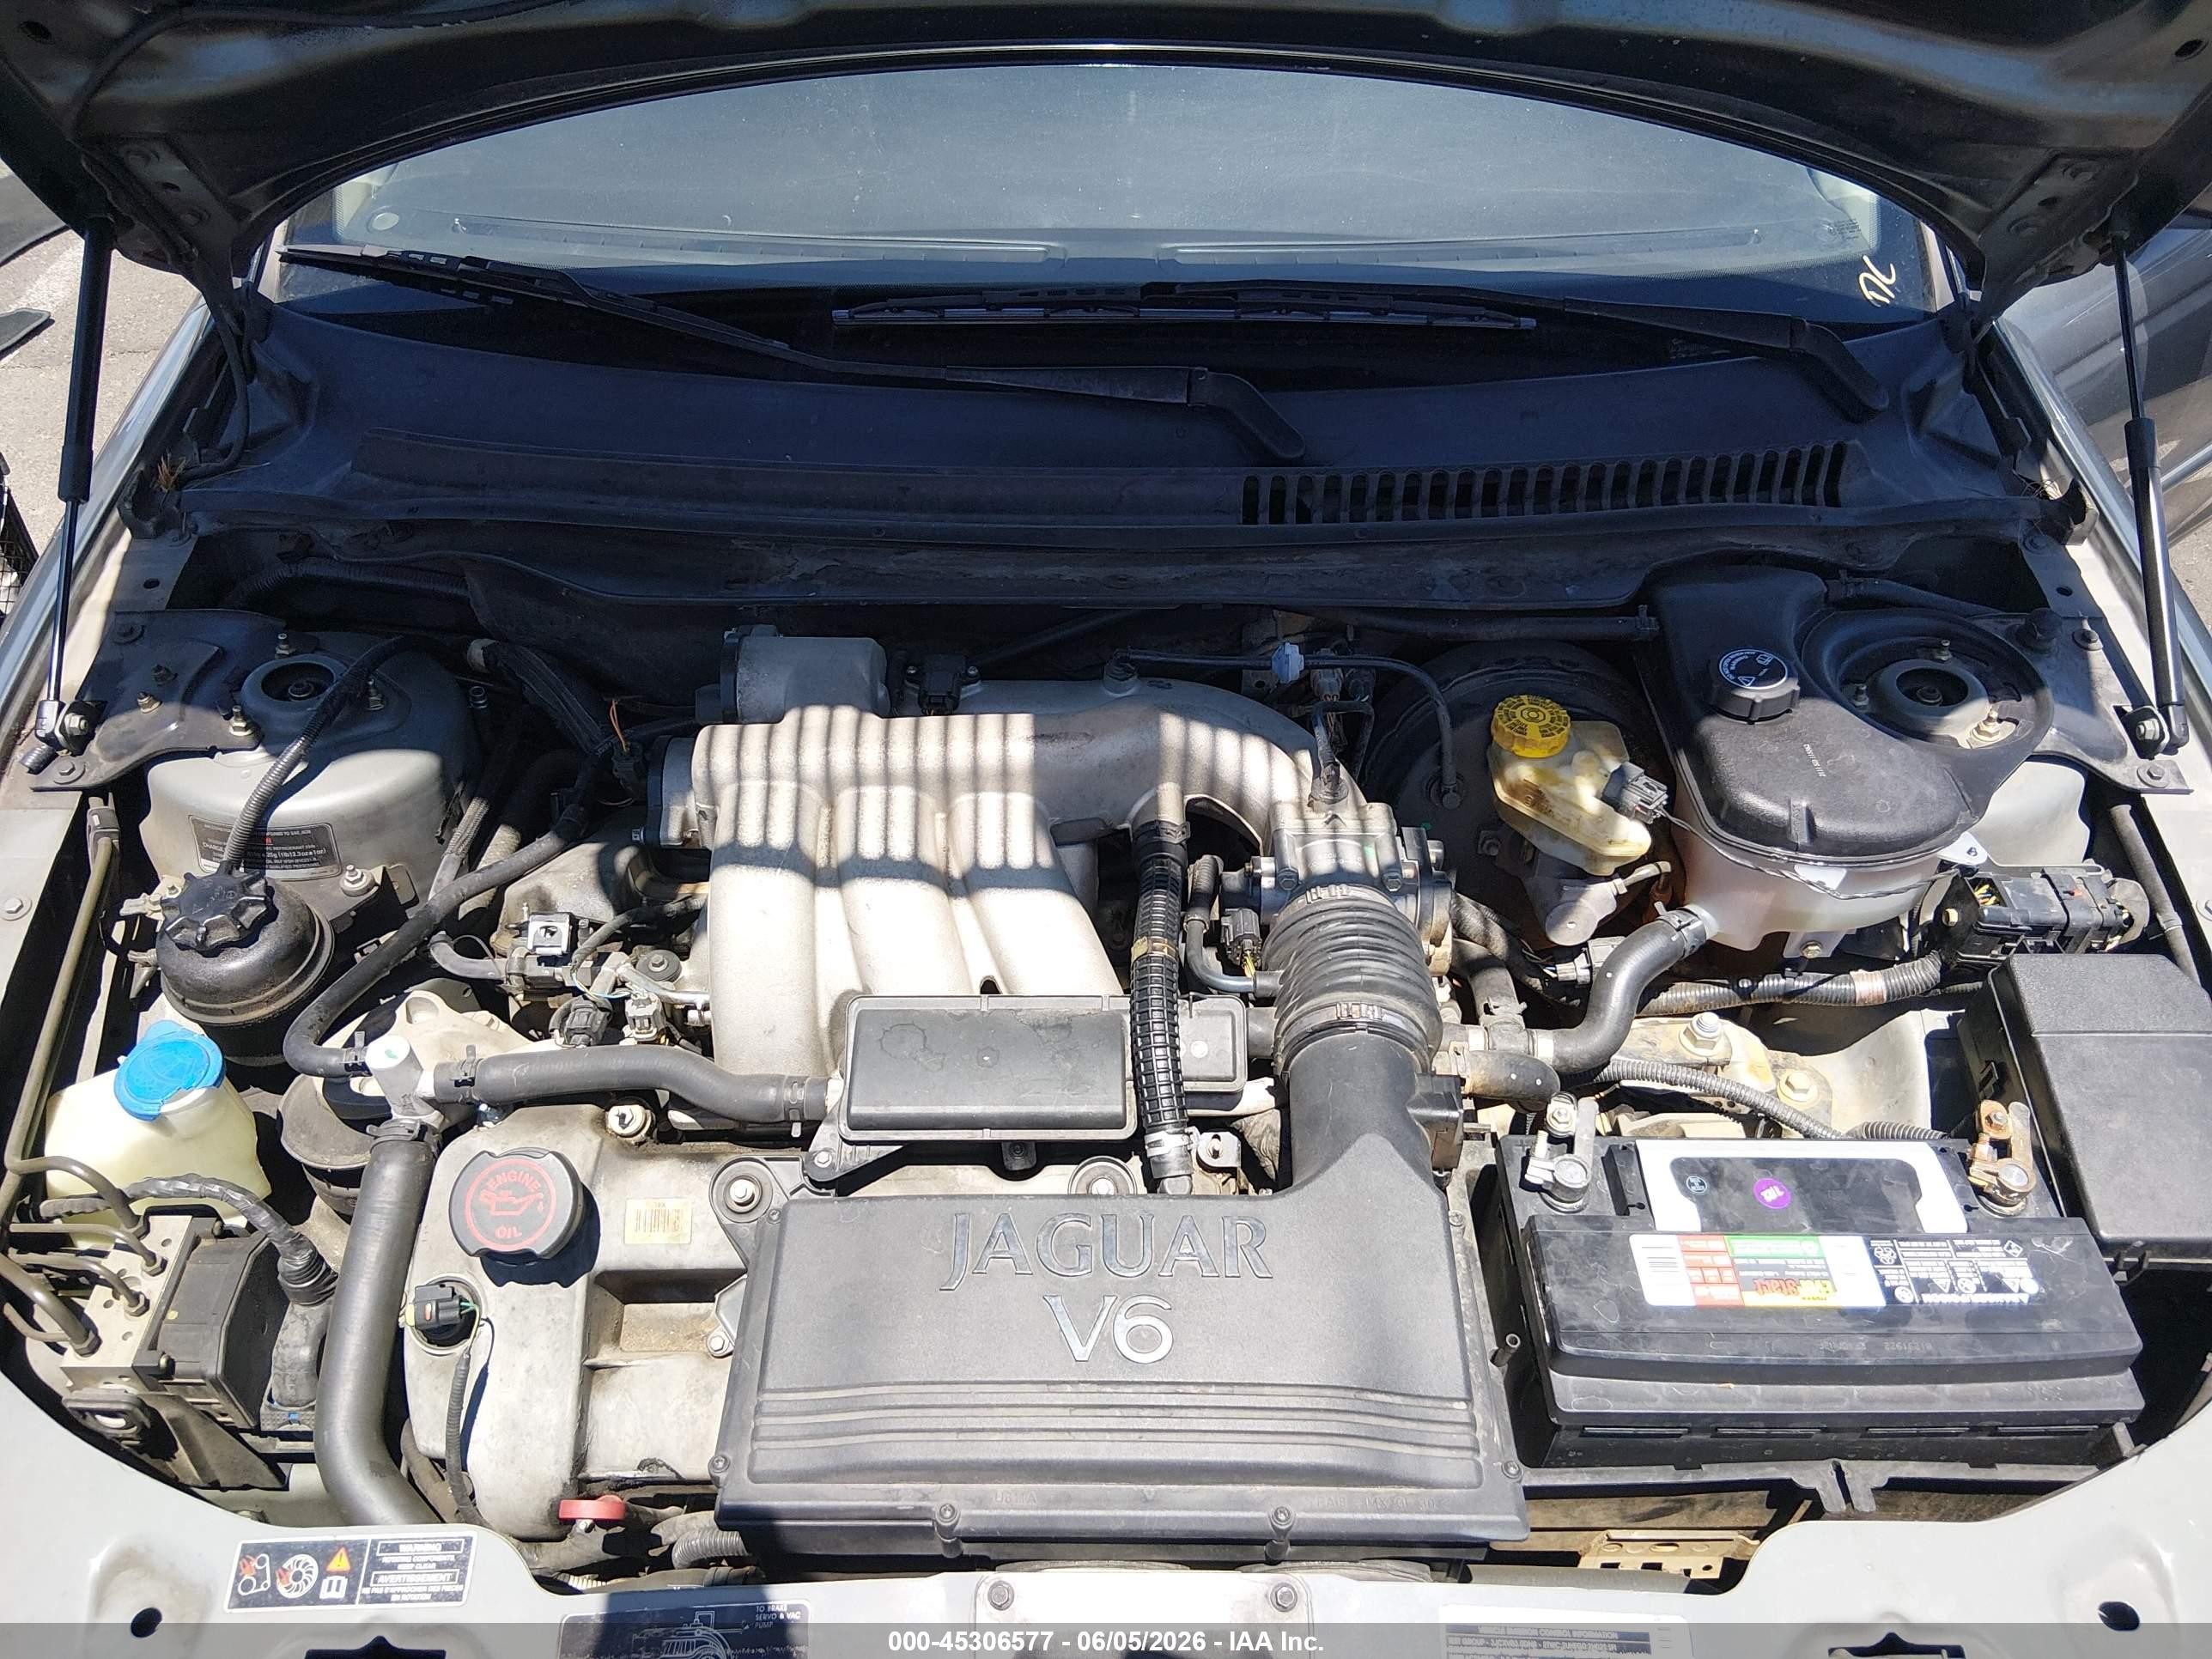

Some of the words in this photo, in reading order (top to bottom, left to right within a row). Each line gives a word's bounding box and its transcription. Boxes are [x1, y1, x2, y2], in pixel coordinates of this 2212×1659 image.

[486, 1170, 541, 1192] ENGINE
[494, 1224, 522, 1239] OIL
[939, 1212, 1273, 1291] JAGUAR
[1042, 1293, 1175, 1365] V6
[398, 1542, 443, 1553] WARNING
[377, 1572, 454, 1584] AVERTISSEMENT
[767, 1604, 788, 1613] BRAKE
[755, 1613, 777, 1621] SERVO
[786, 1611, 801, 1620] VAC
